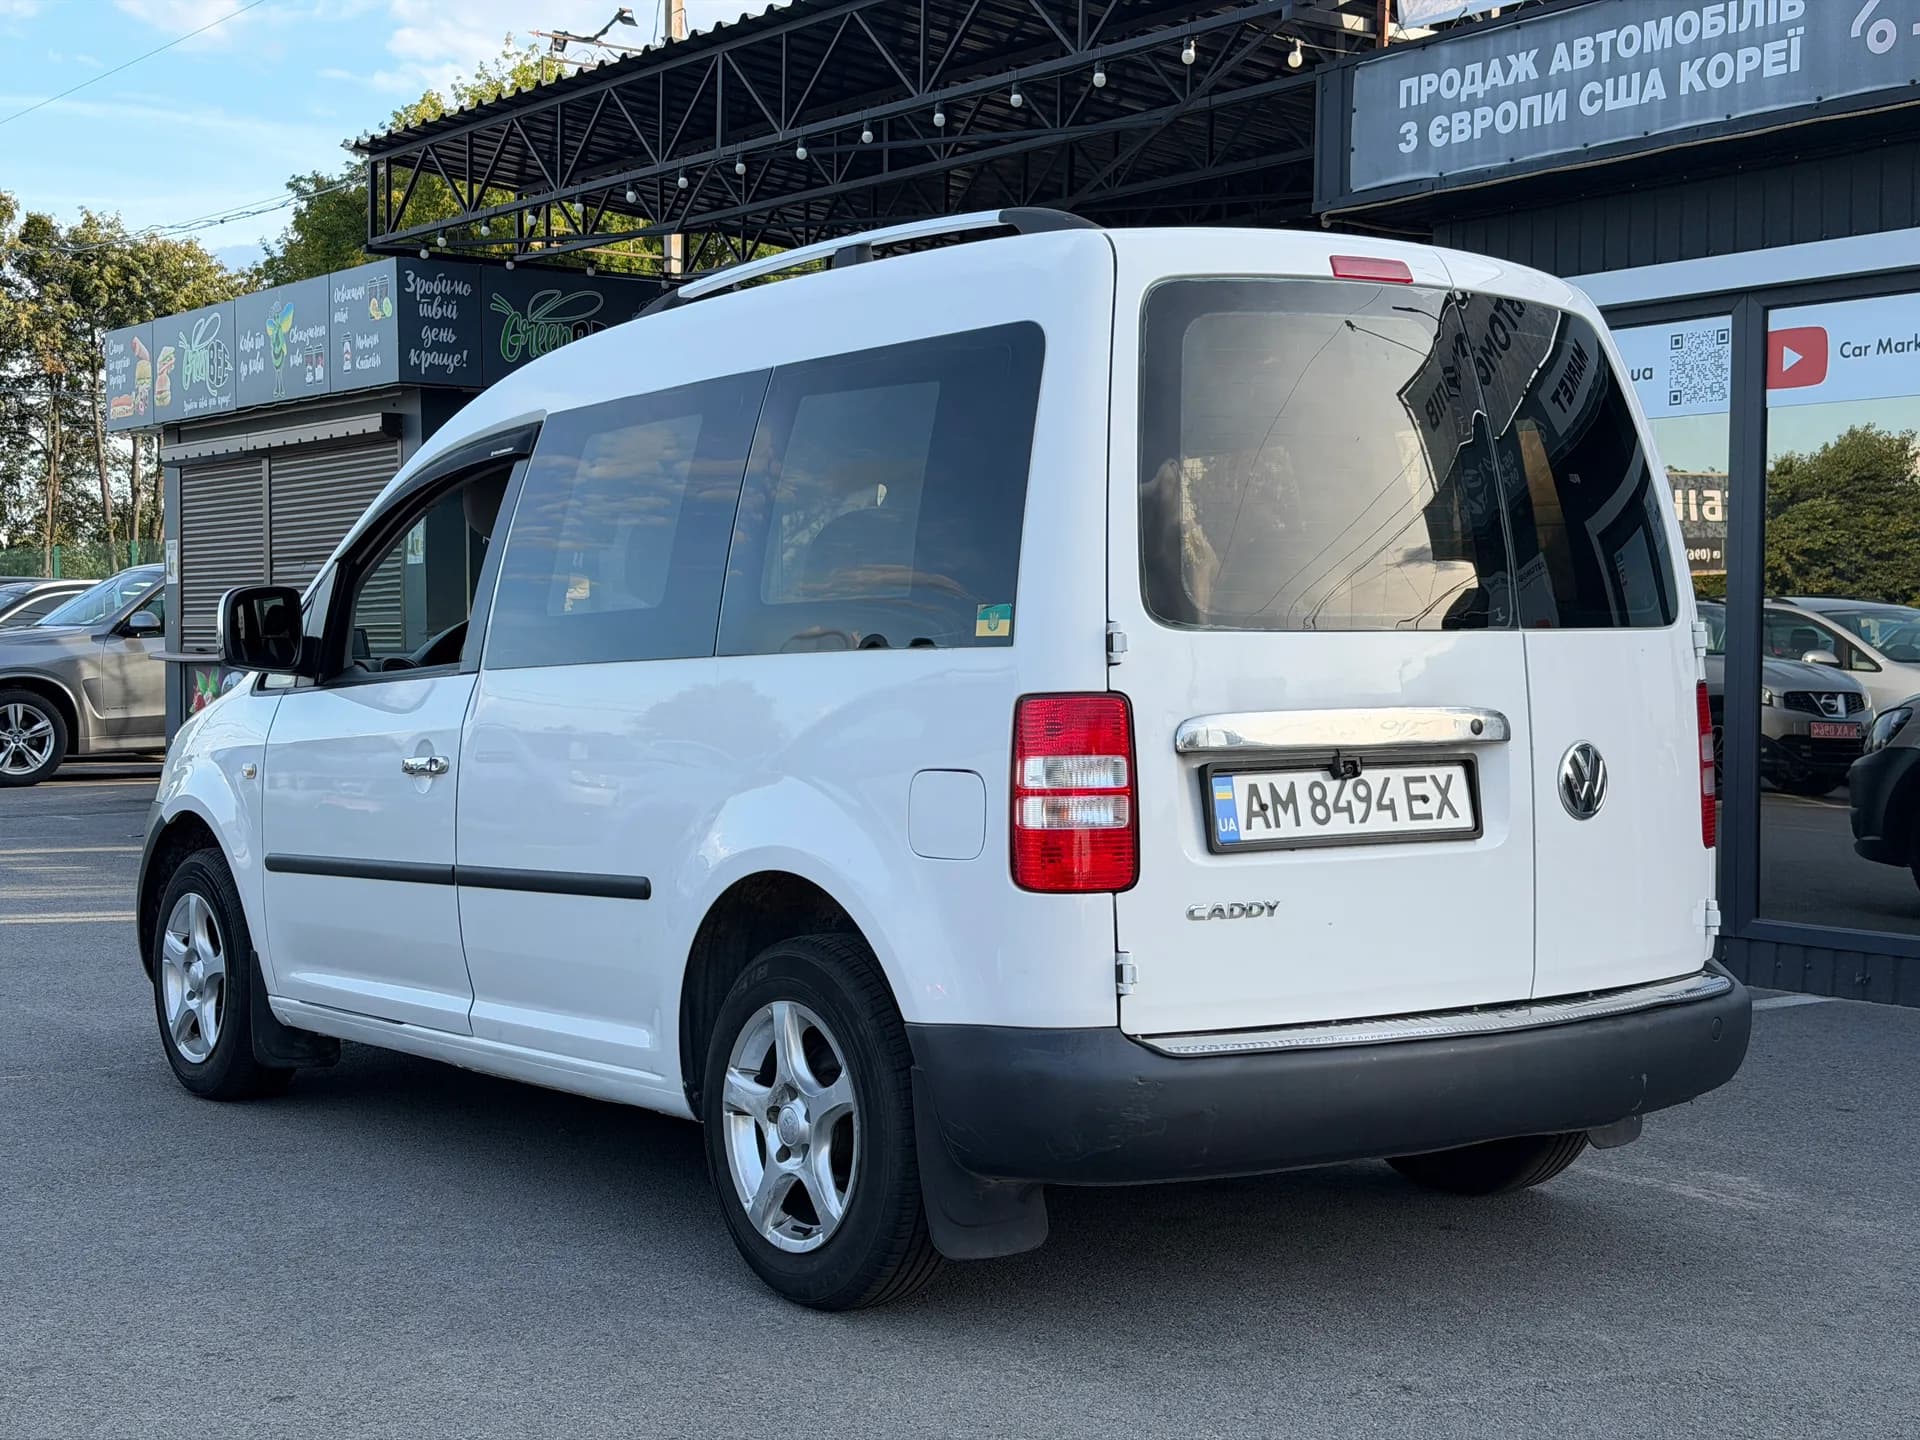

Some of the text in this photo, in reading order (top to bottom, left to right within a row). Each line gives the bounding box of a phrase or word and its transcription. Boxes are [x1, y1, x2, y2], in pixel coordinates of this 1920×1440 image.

[1399, 0, 1805, 108] ПРОДАЖ АВТОМОБІЛІВ
[1398, 27, 1805, 154] З ЄВРОПИ США КОРЕЇ
[404, 270, 472, 301] Зробимо
[418, 296, 458, 320] твій
[421, 325, 457, 348] день
[500, 311, 608, 363] Green
[1839, 333, 1920, 359] Car Mark
[409, 349, 468, 375] краще!
[1631, 367, 1653, 381] ua
[1246, 773, 1460, 832] AM 8494 EX
[1218, 817, 1238, 833] UA
[1186, 899, 1281, 922] CADDY
